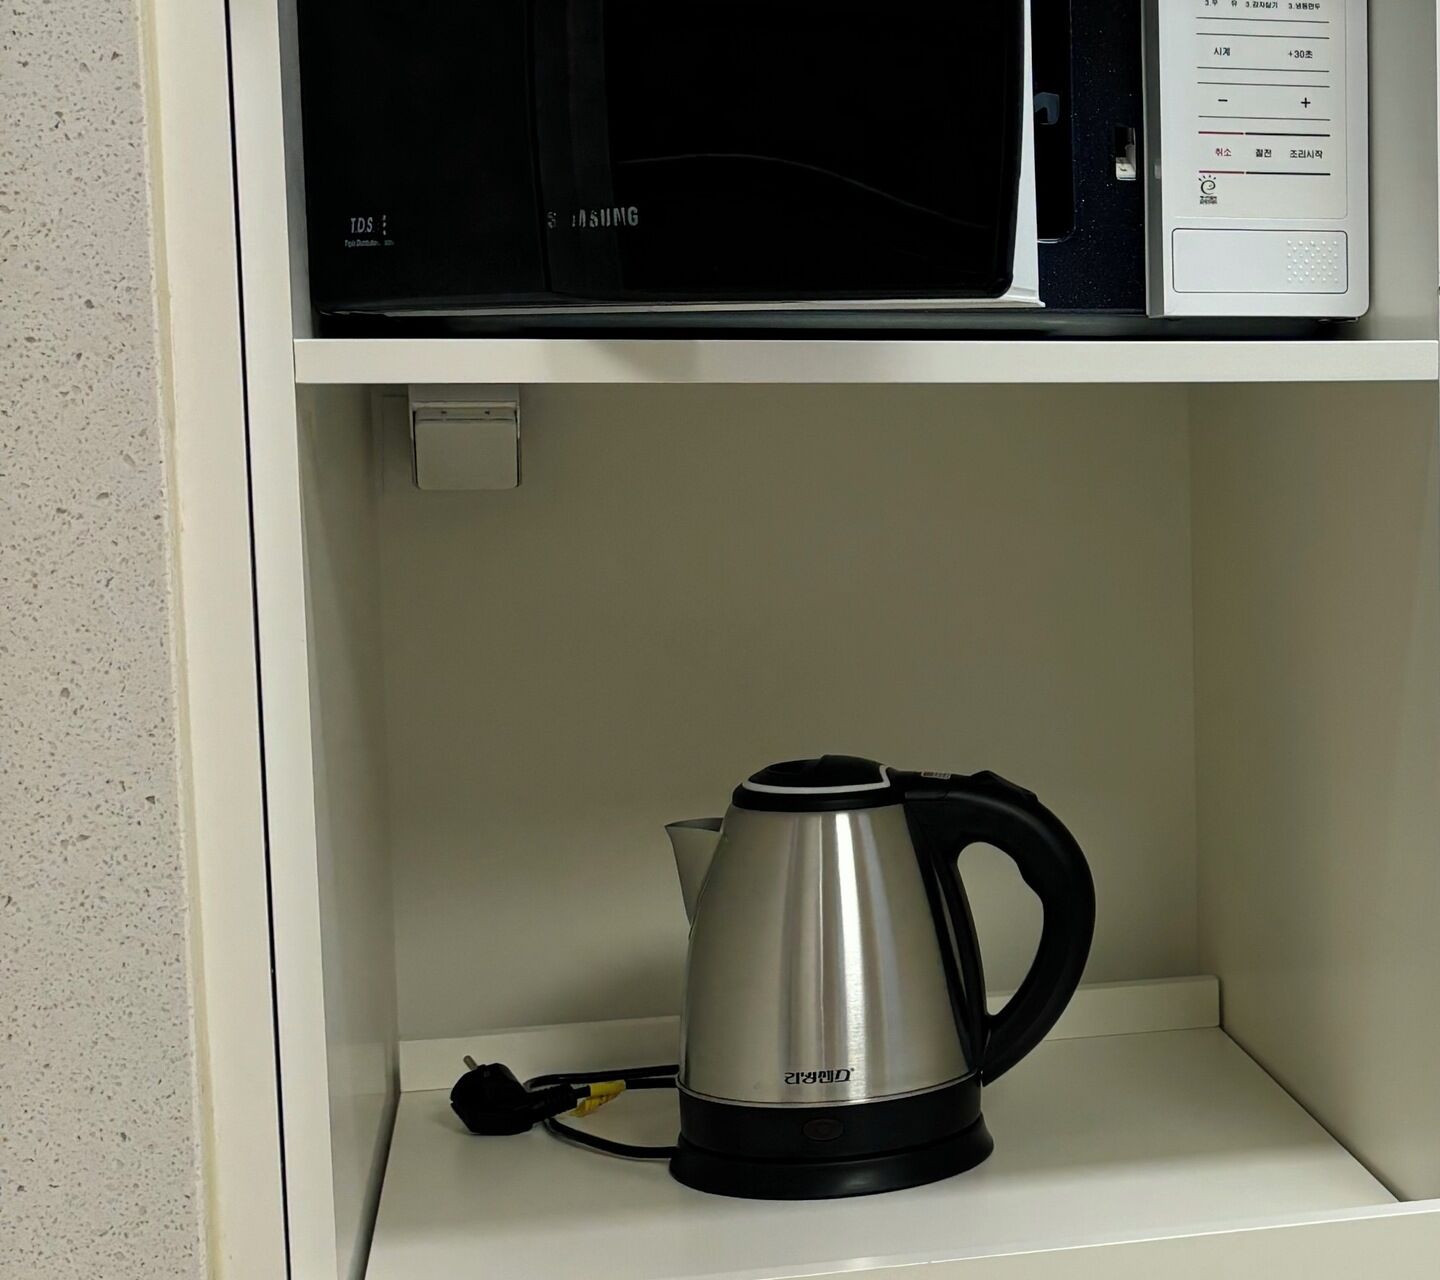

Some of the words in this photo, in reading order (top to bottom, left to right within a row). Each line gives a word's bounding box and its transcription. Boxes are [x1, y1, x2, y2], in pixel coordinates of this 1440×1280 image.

[1214, 46, 1231, 57] 시계
[1288, 49, 1313, 59] +30초
[1215, 147, 1232, 158] 취소
[1255, 148, 1272, 158] 절전
[1290, 149, 1324, 160] 조리시작
